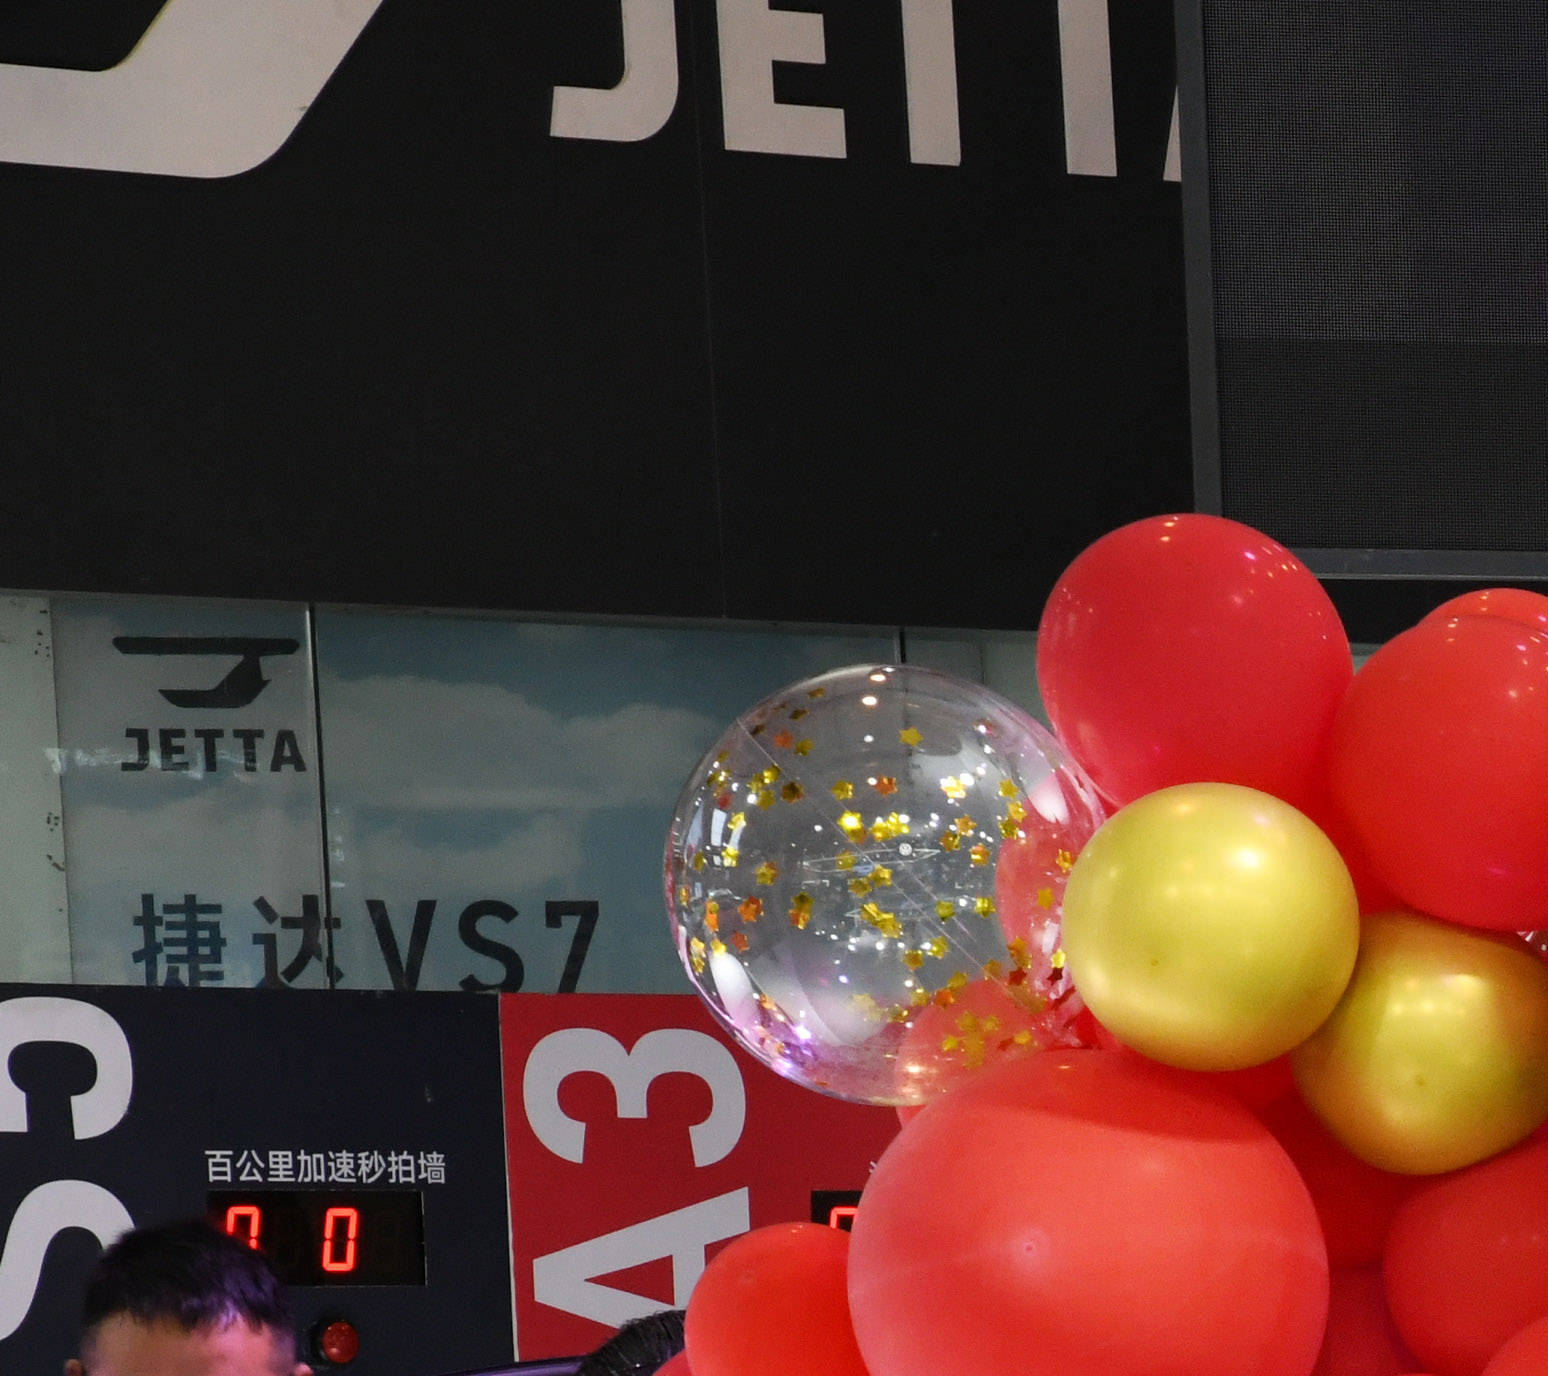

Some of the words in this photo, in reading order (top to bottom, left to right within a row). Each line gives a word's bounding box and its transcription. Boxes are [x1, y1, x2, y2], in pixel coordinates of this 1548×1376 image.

[121, 728, 306, 773] JETTA
[205, 1150, 446, 1185] 百公里加速秒拍墙
